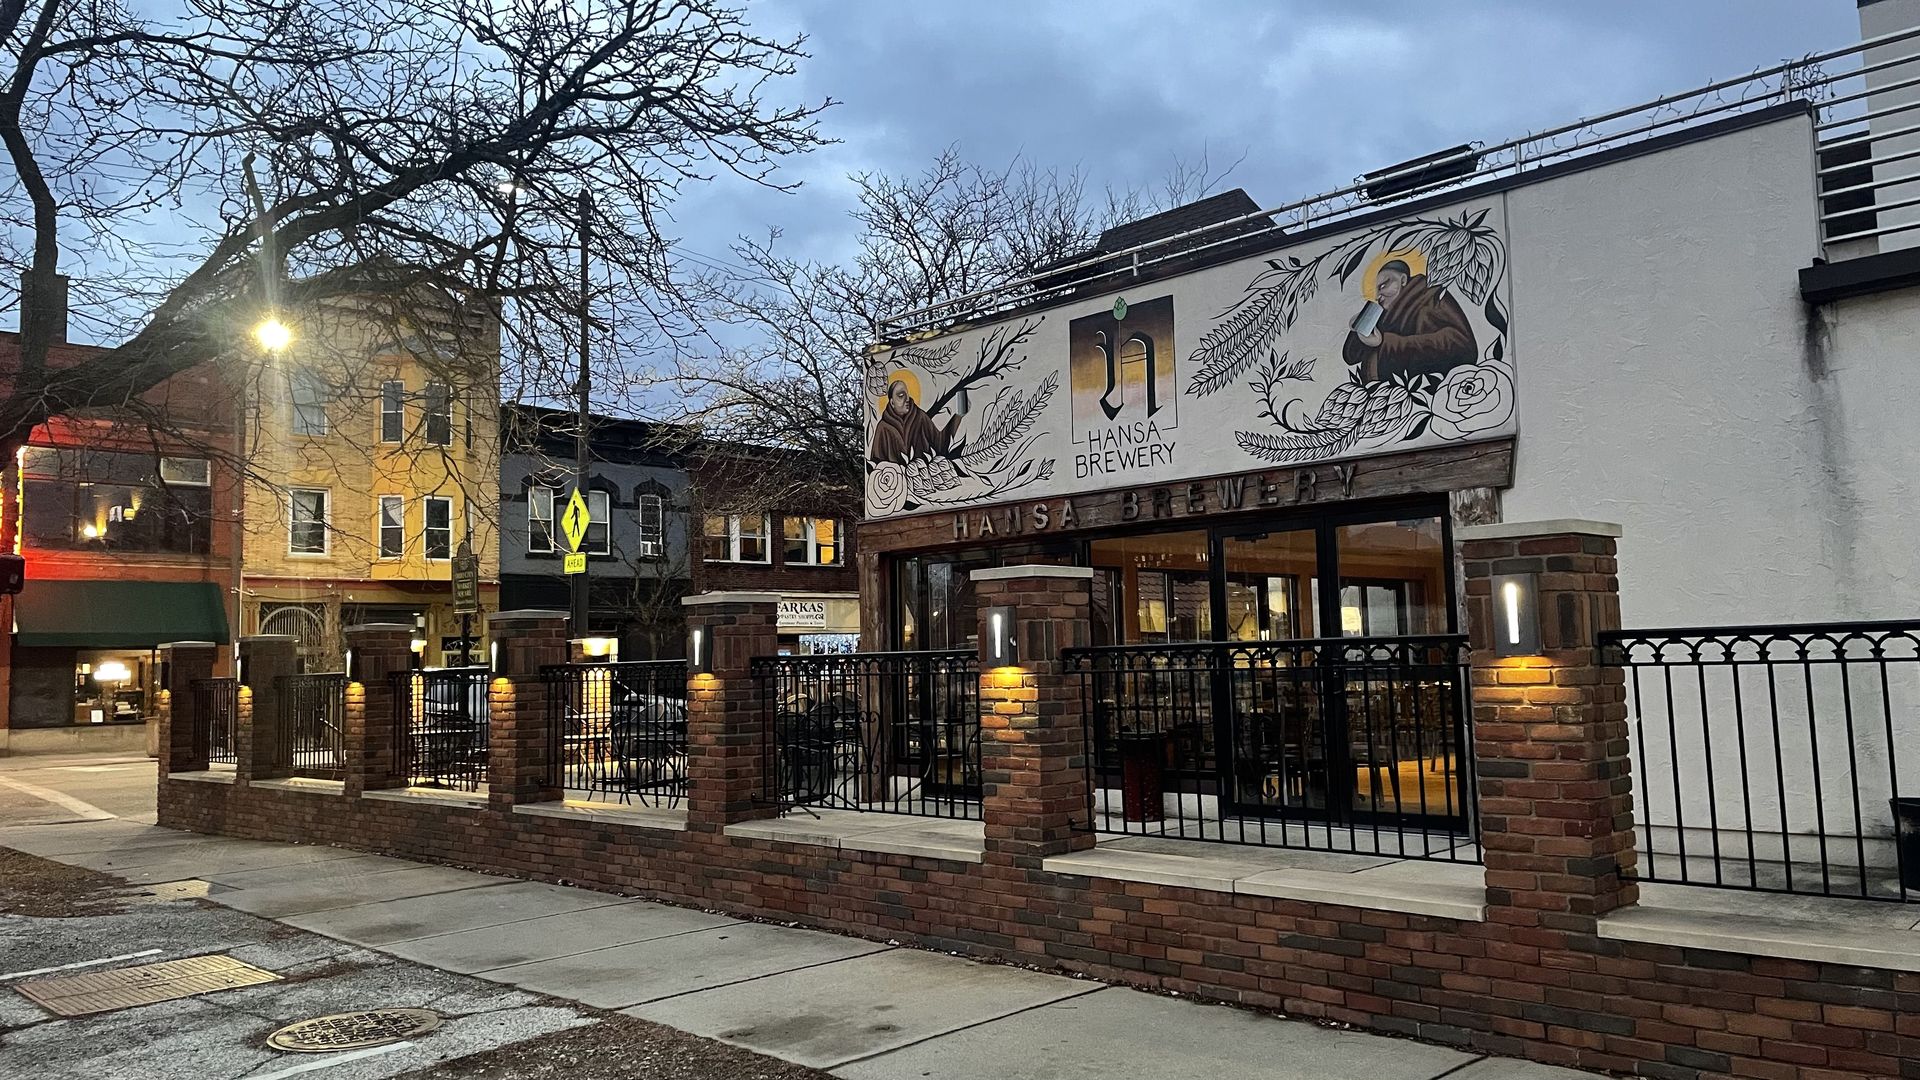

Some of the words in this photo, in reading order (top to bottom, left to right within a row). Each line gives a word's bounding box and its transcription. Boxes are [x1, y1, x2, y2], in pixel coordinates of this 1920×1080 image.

[1088, 420, 1161, 453] HANSA
[1075, 441, 1176, 479] BREWERY
[952, 500, 1080, 540] HANSA
[1121, 464, 1358, 521] BREWERY
[566, 558, 584, 569] AHEAD
